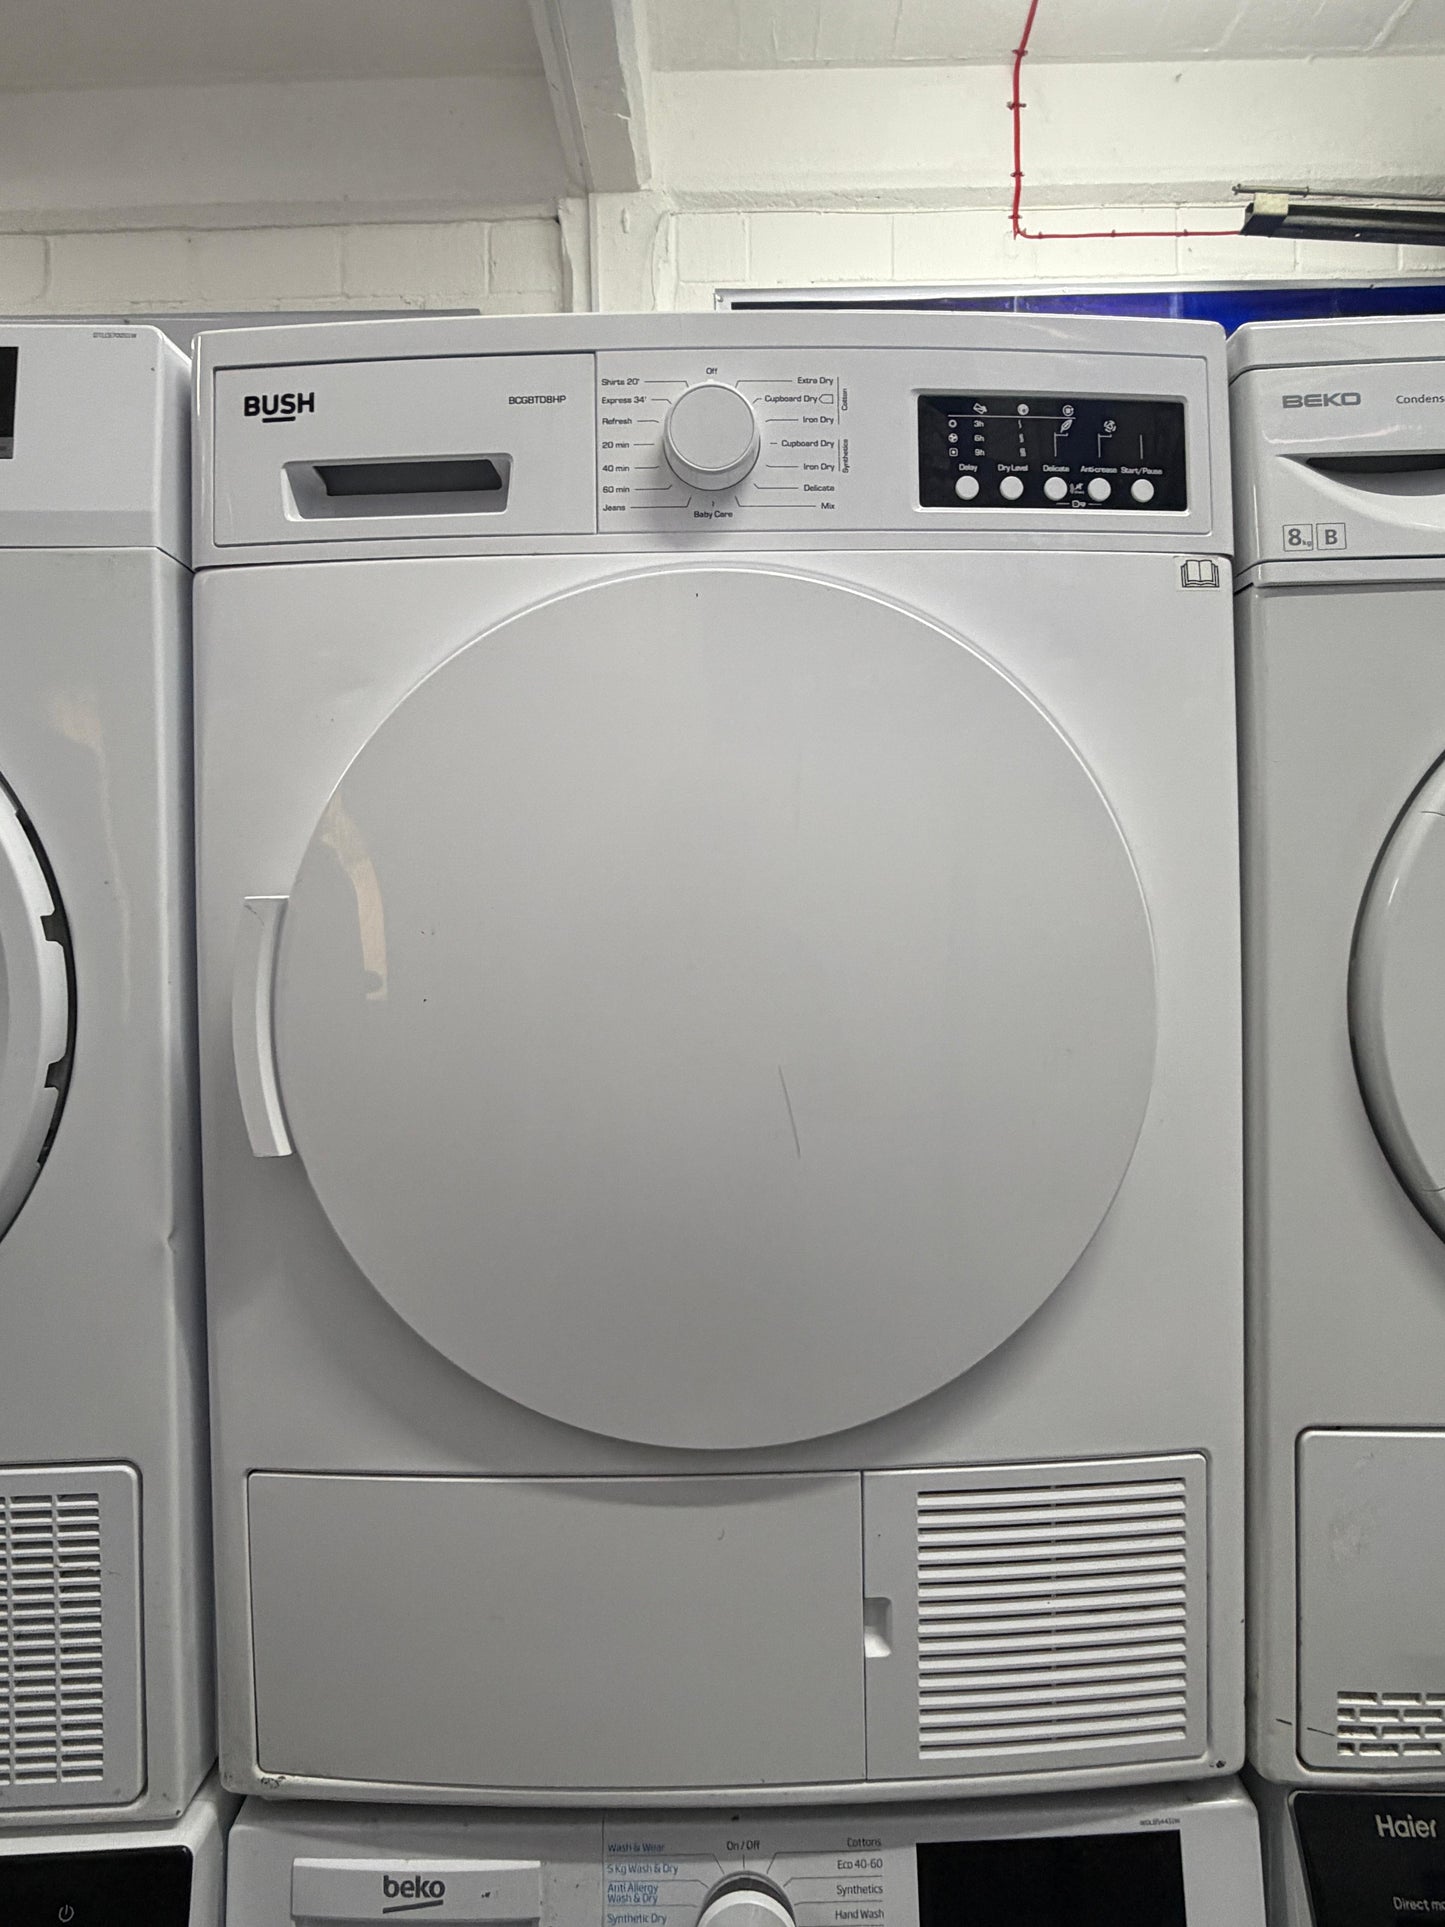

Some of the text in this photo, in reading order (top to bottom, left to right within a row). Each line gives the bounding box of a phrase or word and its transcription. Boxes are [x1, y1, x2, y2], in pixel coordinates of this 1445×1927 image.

[705, 367, 718, 375] Off
[601, 378, 625, 386] Shirts
[797, 376, 834, 385] Extra Dry
[601, 396, 632, 405] Express
[764, 395, 818, 404] Cupboard Dry
[1282, 392, 1361, 409] BEKO
[1396, 394, 1445, 404] Condens
[244, 392, 315, 418] BUSH
[602, 417, 632, 425] Refresh
[819, 416, 834, 425] Dry
[974, 420, 984, 428] 3h
[602, 441, 630, 449] 20 min
[781, 439, 835, 448] Cupboard Dry
[842, 439, 851, 474] Synthetics
[975, 448, 985, 456] 9h
[602, 464, 630, 472] 40 min
[820, 463, 835, 472] Dry
[959, 463, 978, 472] Delay
[998, 464, 1028, 472] Dry Level
[1043, 464, 1070, 472] Delicate
[1121, 466, 1163, 475] Start/Pause
[602, 485, 630, 493] 60 min
[804, 484, 835, 492] Delicate
[602, 503, 626, 512] Jeans
[693, 510, 733, 519] Baby Care
[1325, 529, 1338, 545] B
[1374, 1814, 1438, 1838] Haier
[726, 1840, 739, 1850] On
[746, 1840, 760, 1850] Off
[847, 1837, 882, 1848] Cottons
[837, 1858, 883, 1870] Eco 40-60
[615, 1864, 627, 1875] kg
[628, 1864, 652, 1873] Wash
[654, 1864, 661, 1873] &
[662, 1864, 678, 1876] Dry
[383, 1875, 445, 1899] beko
[607, 1882, 659, 1895] Anti Allergy
[836, 1884, 884, 1896] Synthetics
[607, 1893, 658, 1906] Wash & Dry
[1393, 1896, 1430, 1912] Direct
[835, 1909, 885, 1920] Hand Wash
[607, 1913, 667, 1926] Synthetic Dry
